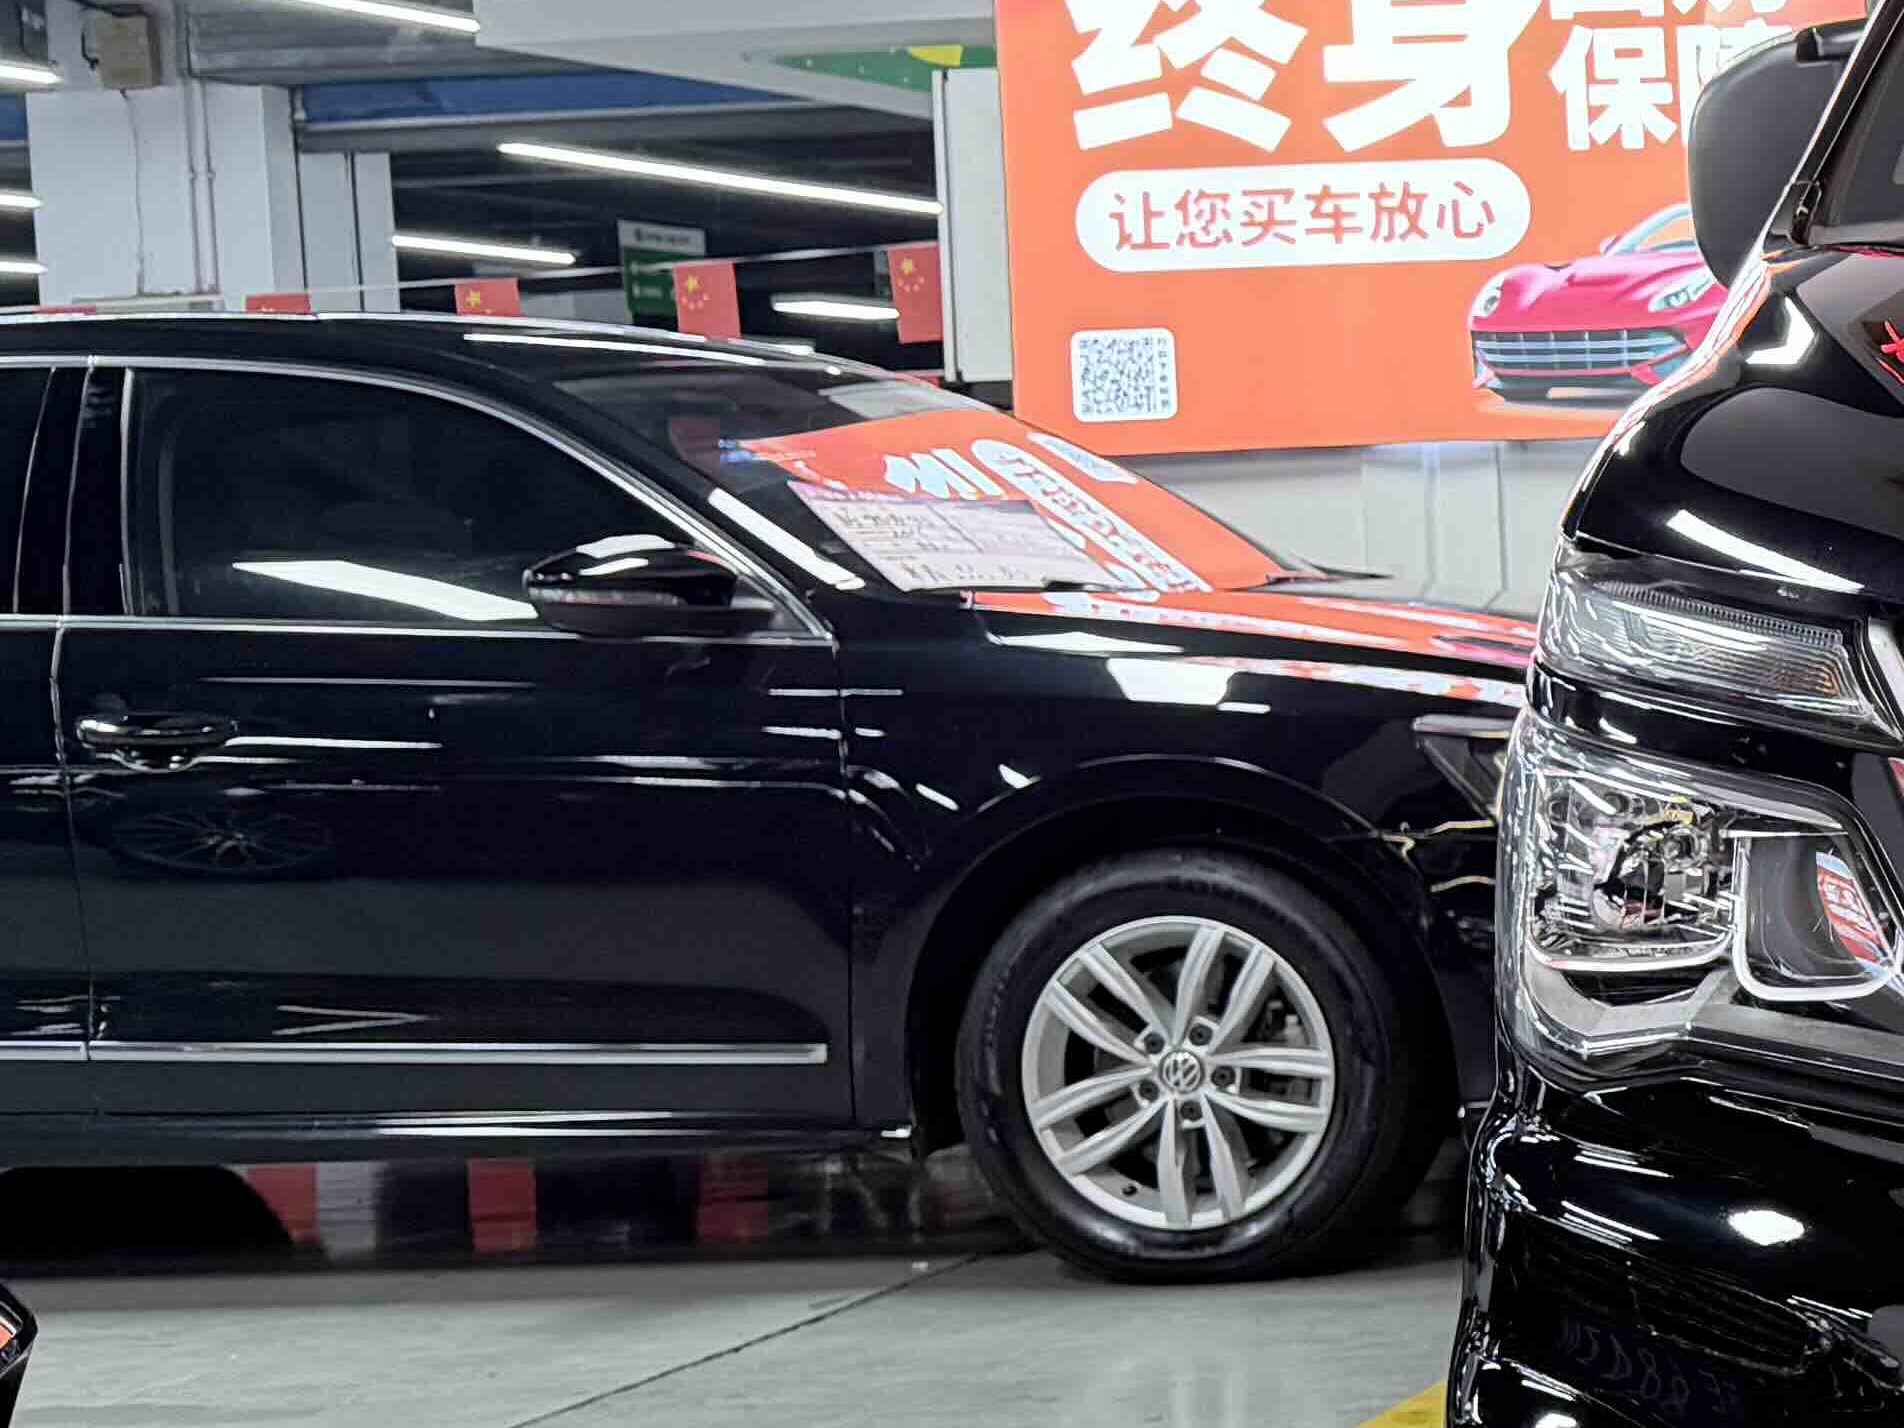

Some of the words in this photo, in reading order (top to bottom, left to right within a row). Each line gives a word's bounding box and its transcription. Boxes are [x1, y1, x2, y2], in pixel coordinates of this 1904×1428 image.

[1109, 179, 1495, 251] 让您买车放心
